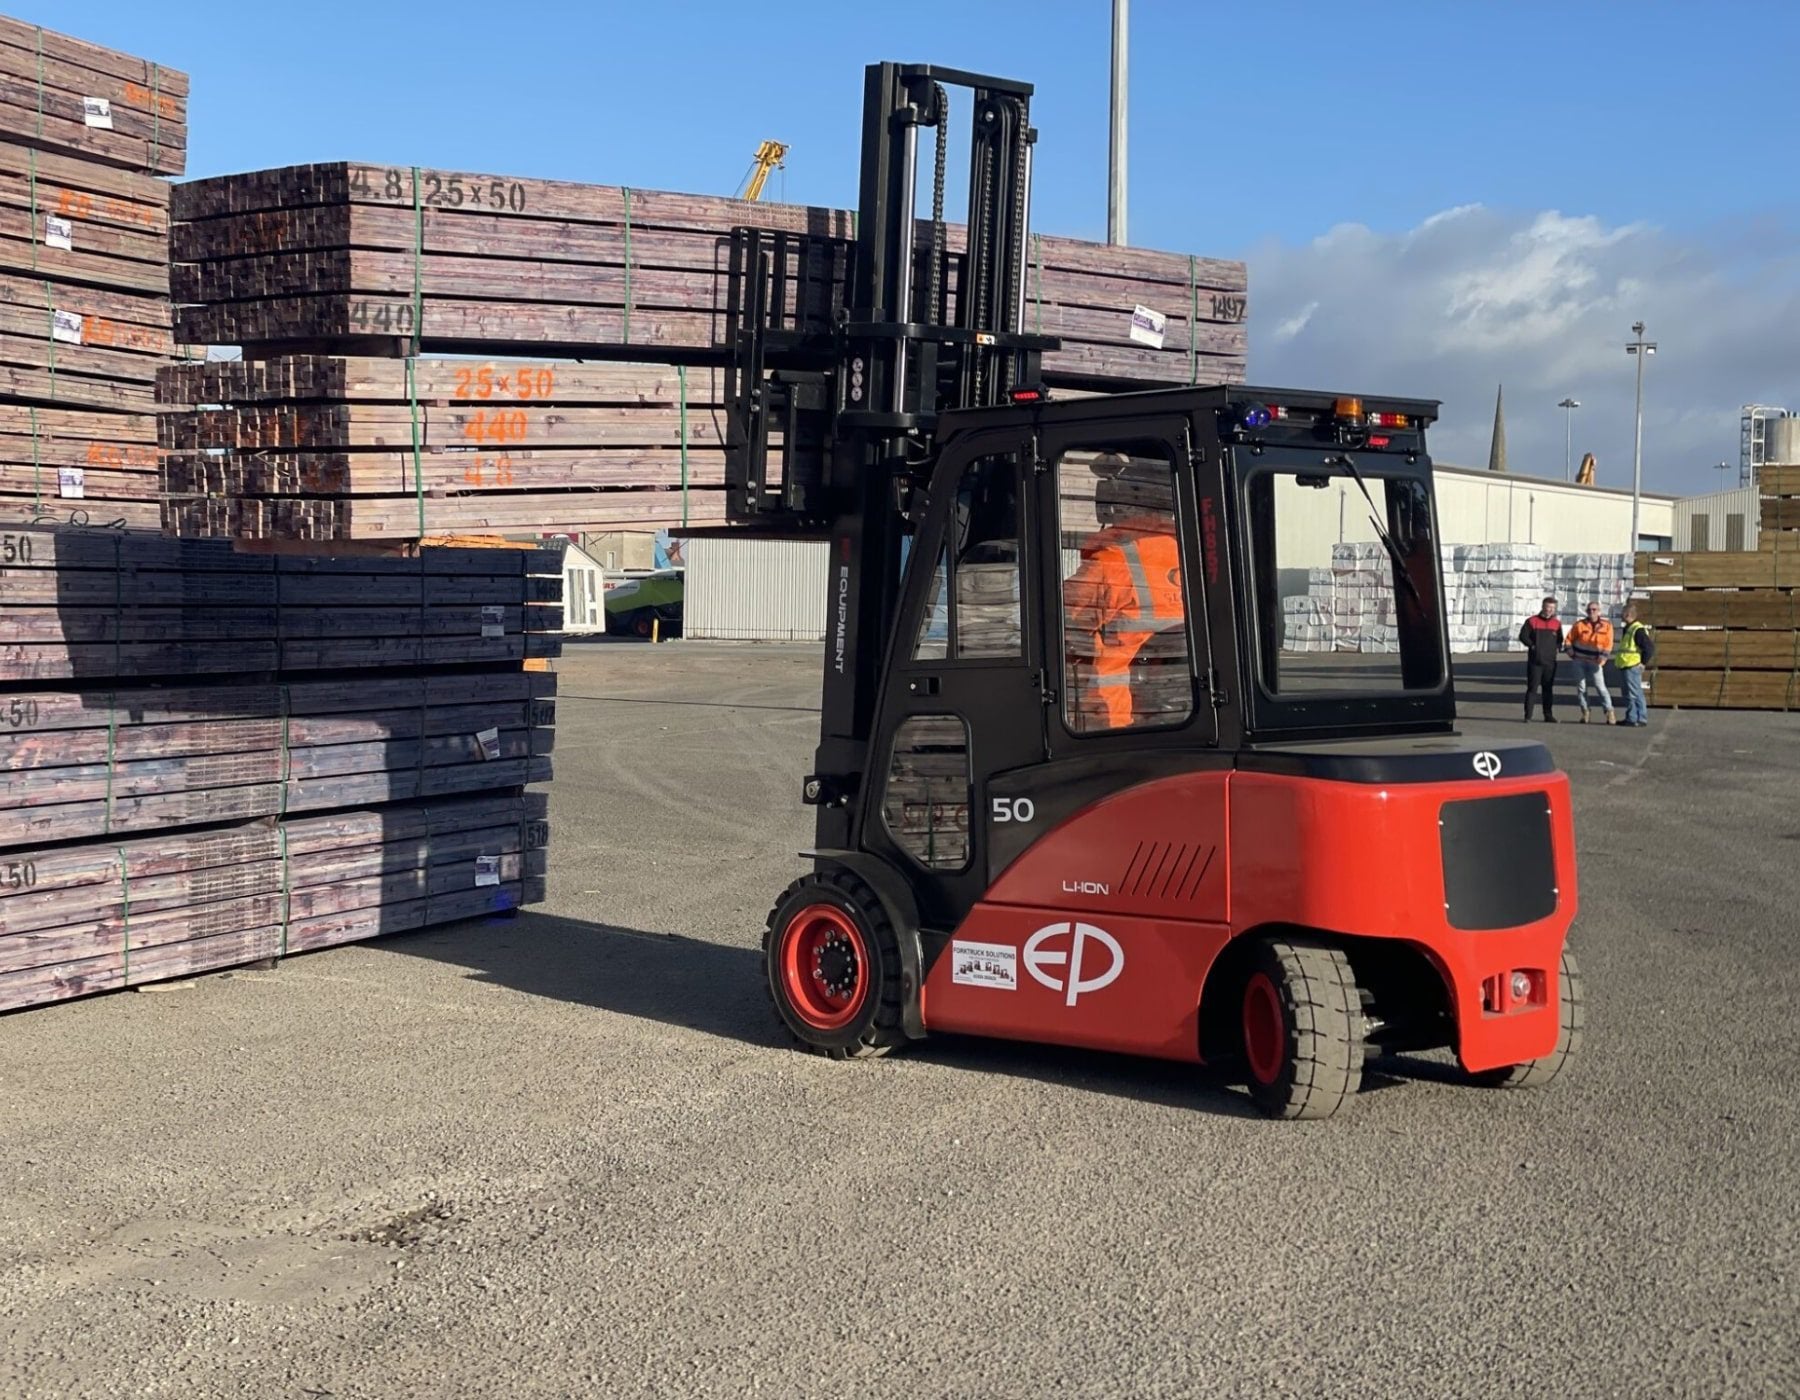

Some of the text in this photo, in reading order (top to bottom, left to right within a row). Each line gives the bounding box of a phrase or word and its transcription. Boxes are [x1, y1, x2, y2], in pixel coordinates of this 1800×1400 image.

[351, 168, 403, 200] 4.8
[350, 302, 414, 334] 440
[1209, 294, 1247, 320] 1497
[465, 410, 528, 444] 440
[835, 565, 849, 674] EQUIPMENT
[993, 797, 1035, 822] 50
[954, 946, 985, 957] FORKTRUCK
[985, 950, 1015, 960] SOLUTIONS
[1022, 921, 1125, 1007] EP
